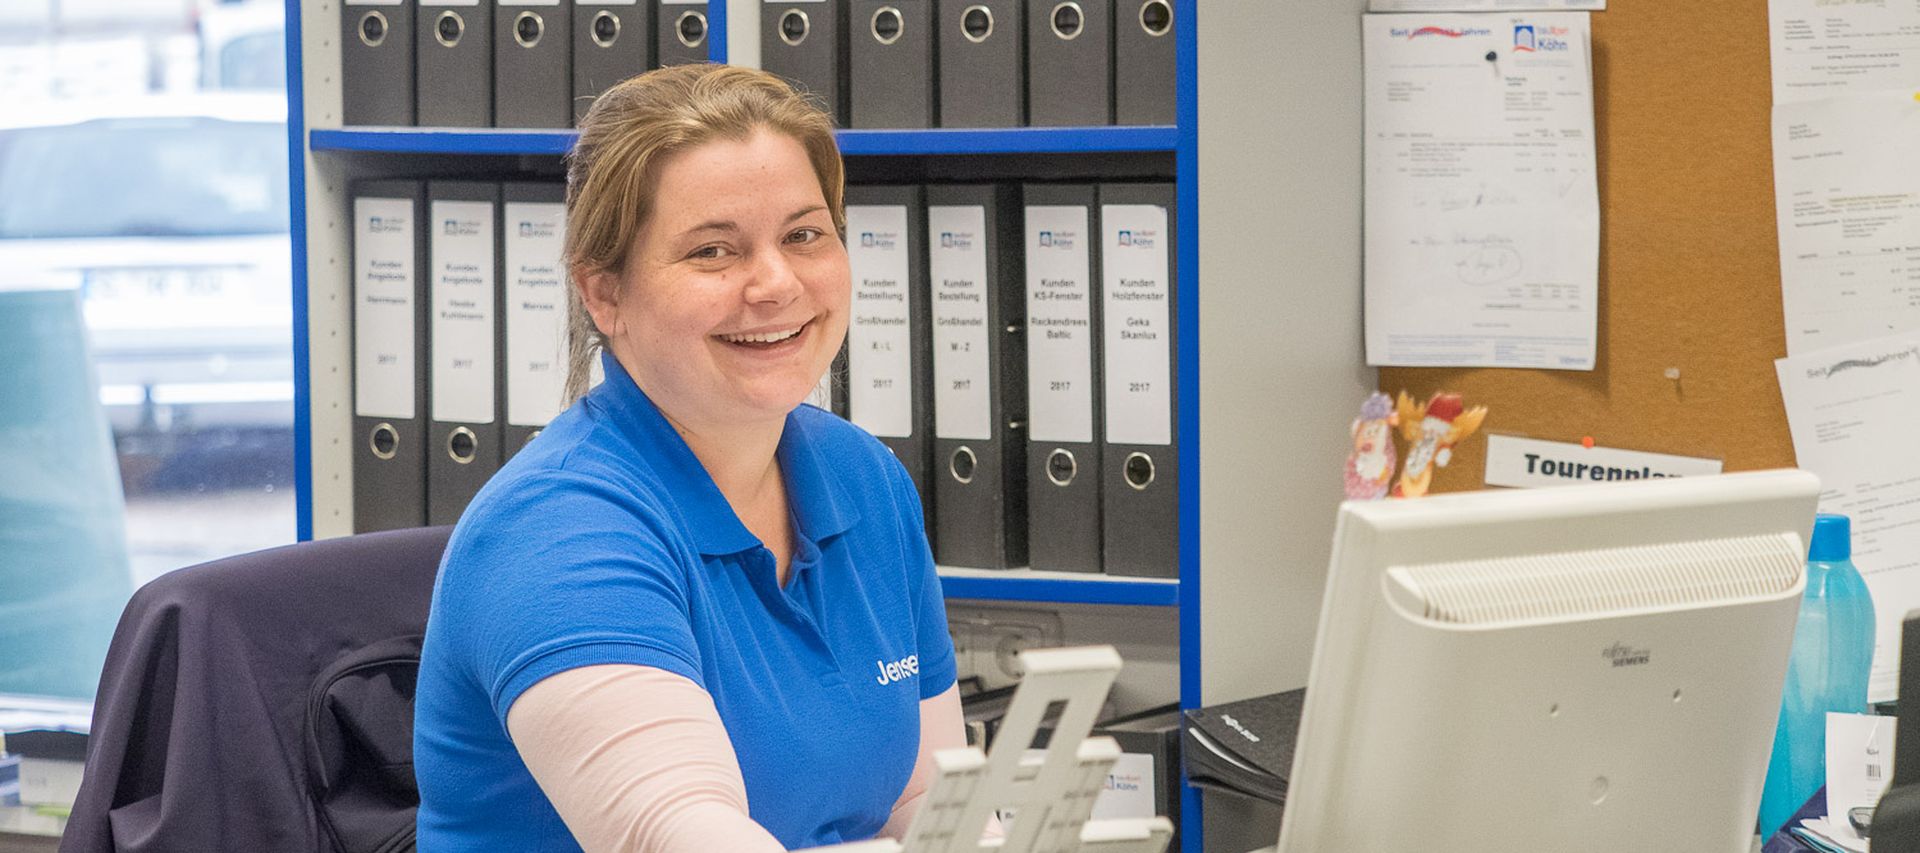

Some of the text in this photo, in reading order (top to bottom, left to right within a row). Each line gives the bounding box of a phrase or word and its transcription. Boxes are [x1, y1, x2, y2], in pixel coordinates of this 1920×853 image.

[1537, 38, 1568, 51] Köhn
[863, 279, 897, 289] Kunden
[943, 279, 974, 289] Kunden
[1041, 278, 1075, 288] Kunden
[1120, 278, 1155, 289] Kunden
[857, 291, 904, 302] Bestellung
[938, 291, 980, 303] Bestellung
[1033, 291, 1083, 301] KS-Fenster
[1111, 291, 1165, 301] Holzfenster
[1126, 316, 1150, 327] Geka
[1046, 329, 1072, 340] Baltic
[1050, 380, 1071, 391] 2017
[1129, 381, 1151, 393] 2017
[876, 654, 919, 686] Jense
